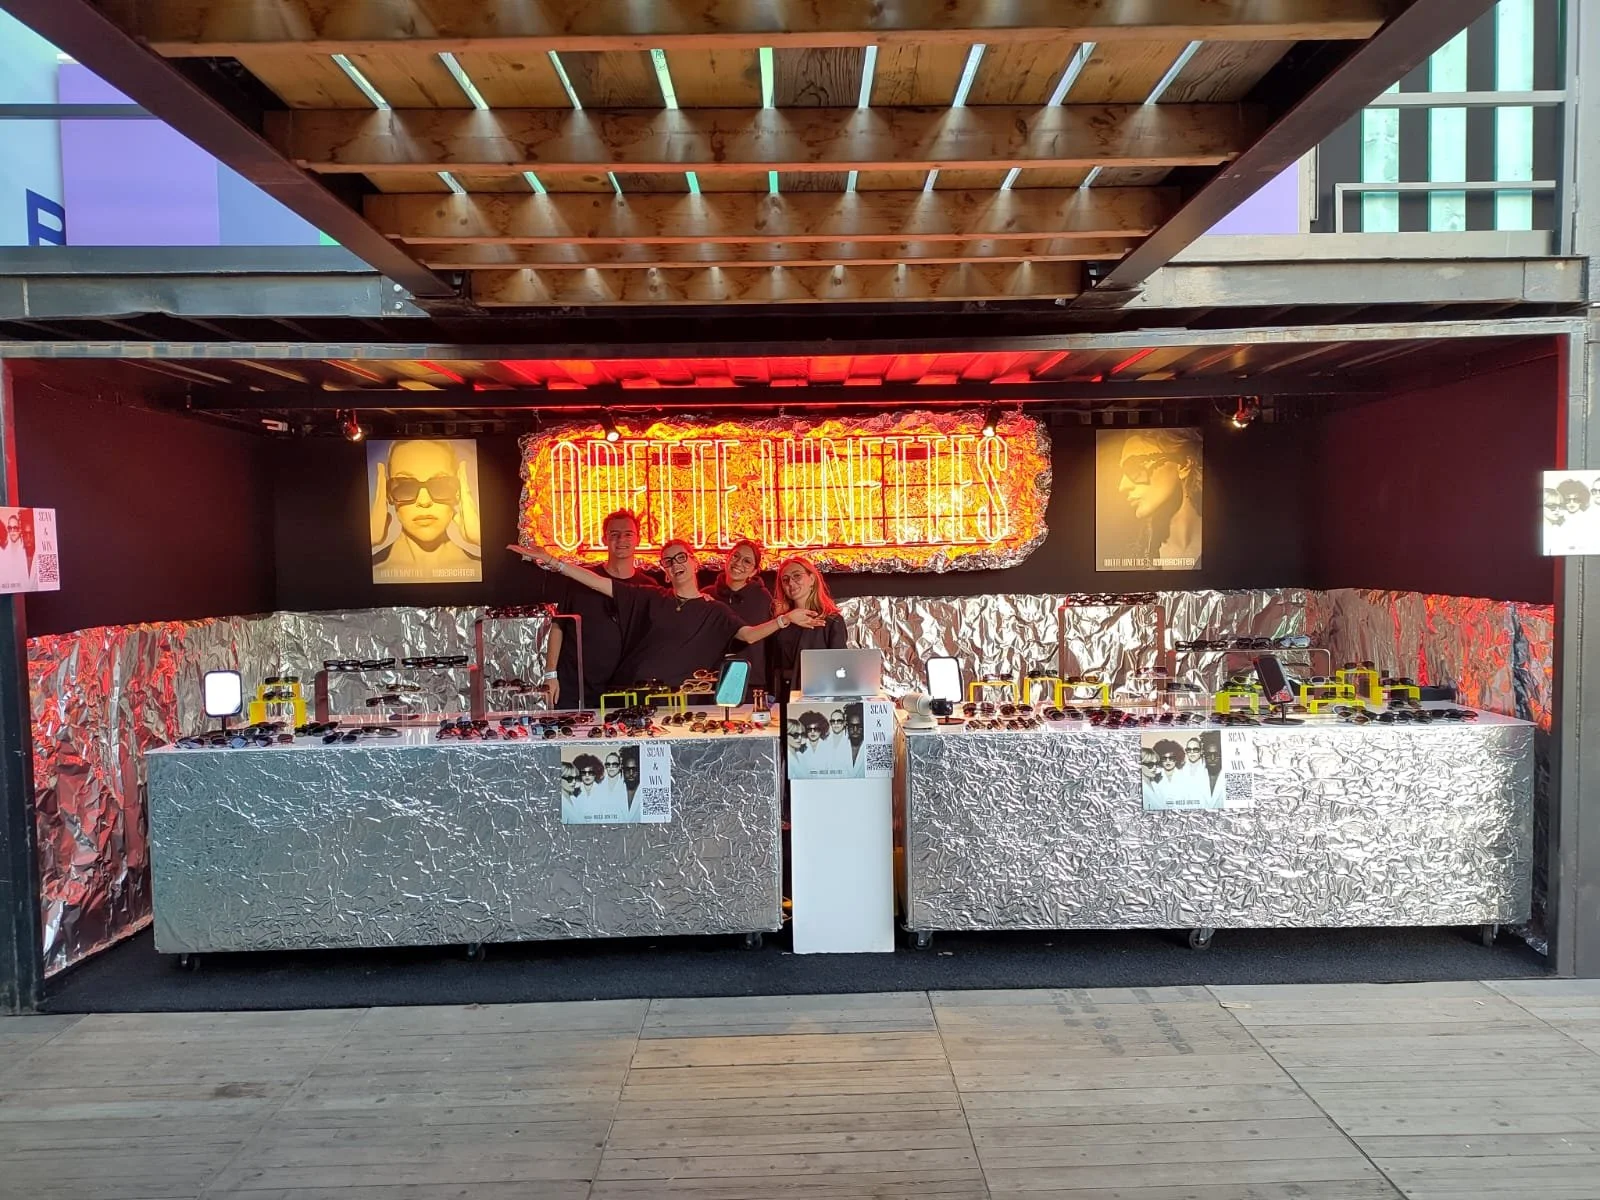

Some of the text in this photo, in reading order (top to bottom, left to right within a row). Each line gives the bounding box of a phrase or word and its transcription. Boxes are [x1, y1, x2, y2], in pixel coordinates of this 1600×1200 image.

[551, 436, 1008, 550] ODETTE LUNETTES
[870, 704, 888, 714] SCAN
[876, 719, 882, 727] &
[872, 731, 886, 742] WIN
[646, 747, 665, 757] SCAN
[649, 775, 663, 785] WIN
